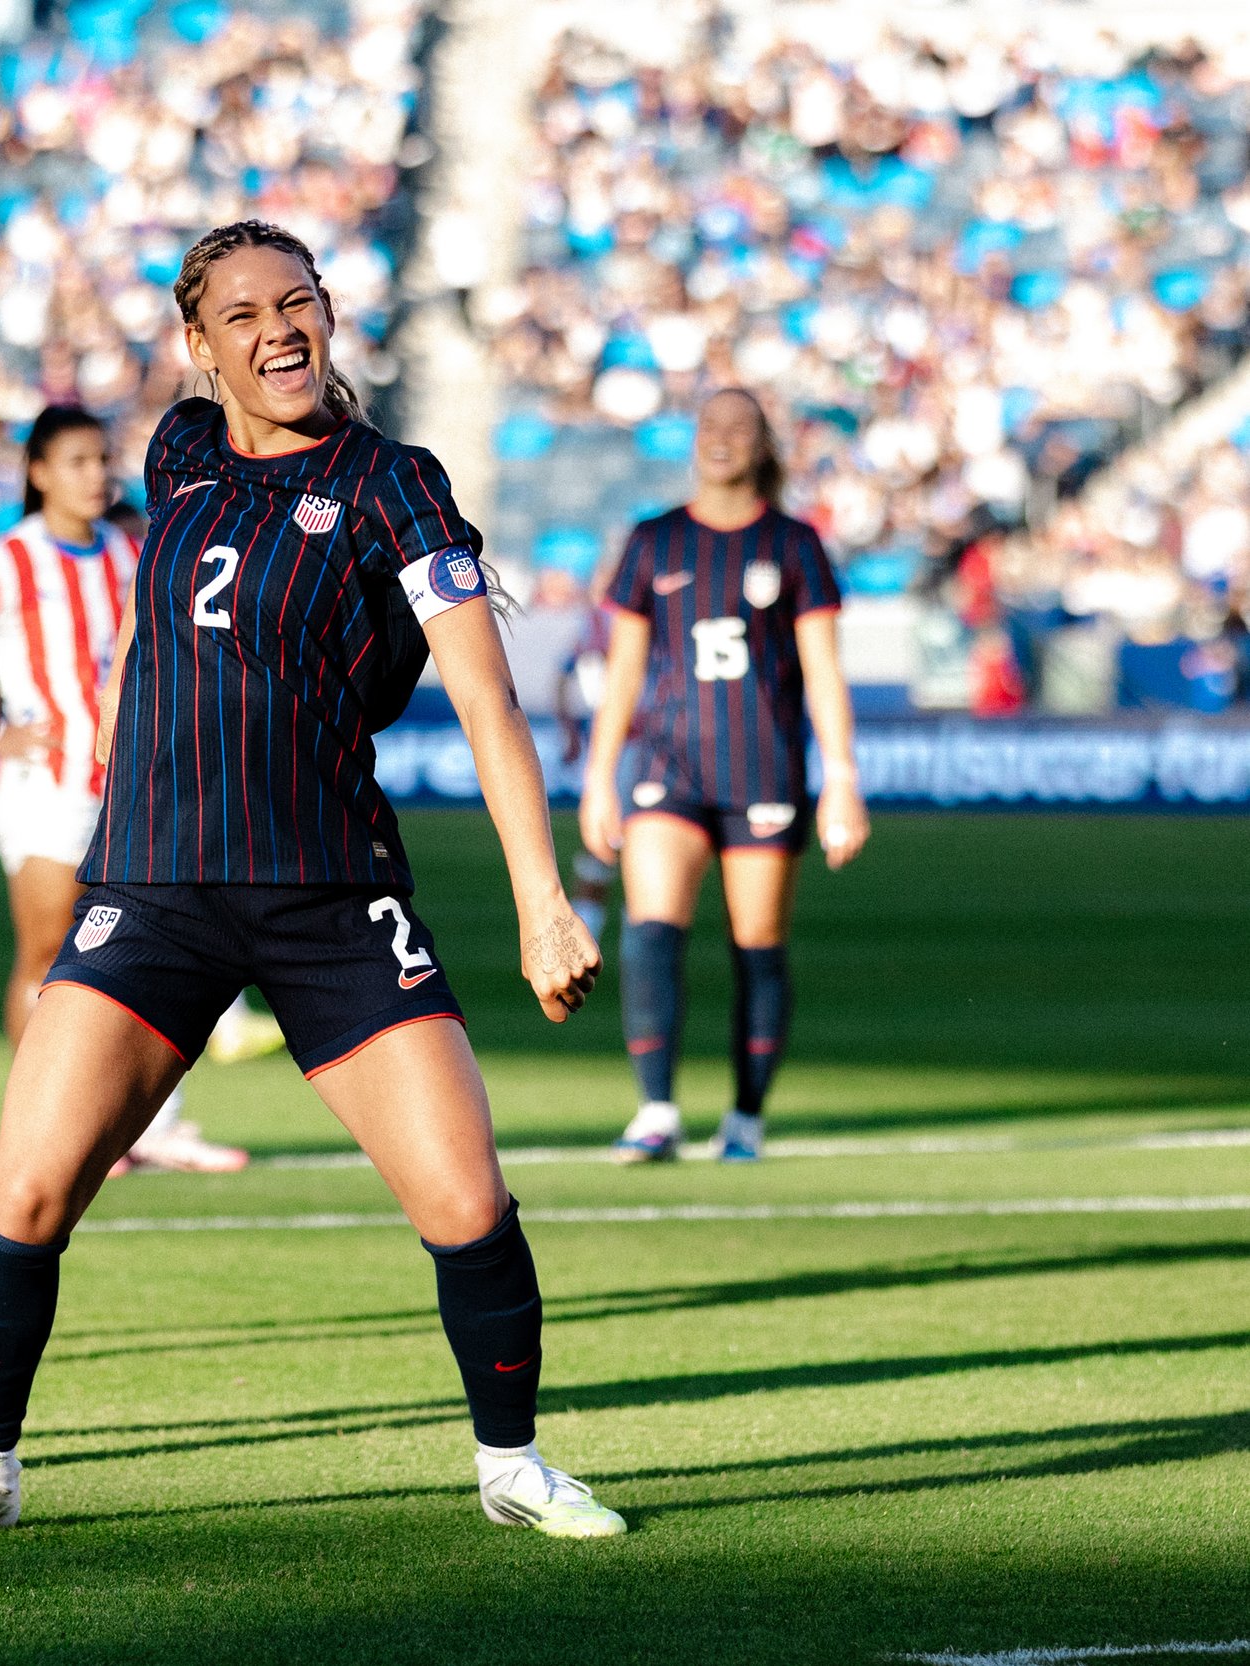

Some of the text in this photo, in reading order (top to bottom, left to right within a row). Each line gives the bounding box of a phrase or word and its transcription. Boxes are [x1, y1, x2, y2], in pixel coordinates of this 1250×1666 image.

[193, 545, 239, 629] 2
[449, 558, 473, 573] USA
[692, 616, 749, 681] 15
[88, 909, 118, 927] USA
[368, 896, 432, 969] 2
